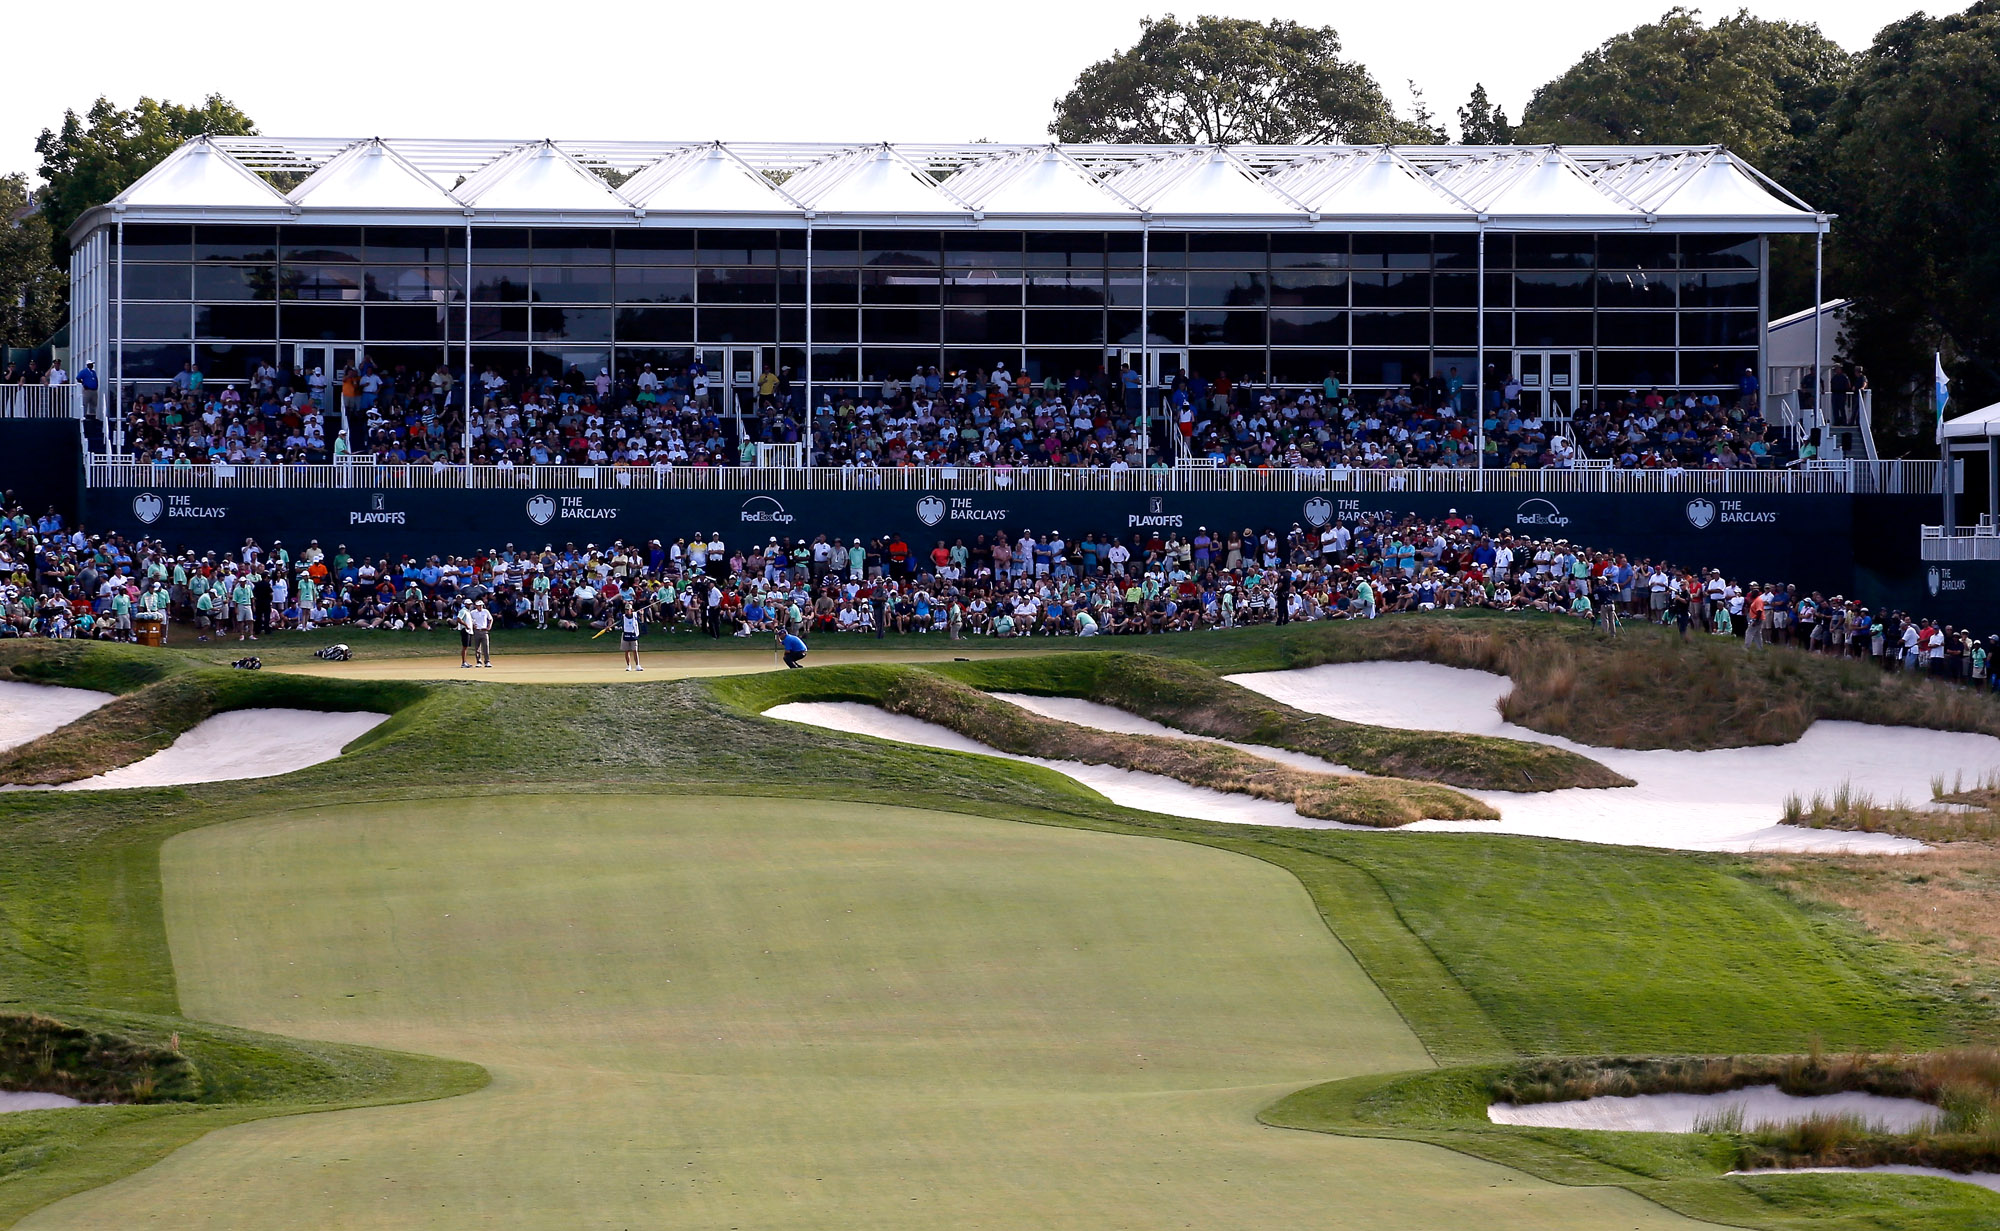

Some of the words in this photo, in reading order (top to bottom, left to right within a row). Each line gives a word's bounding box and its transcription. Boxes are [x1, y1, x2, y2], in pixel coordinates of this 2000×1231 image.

[168, 495, 190, 506] THE
[560, 496, 583, 507] THE
[950, 498, 972, 509] THE
[1337, 499, 1360, 510] THE
[1720, 500, 1742, 511] THE
[168, 507, 226, 518] BARCLAYS
[350, 511, 406, 525] PLAYOFFS
[561, 508, 617, 519] BARCLAYS
[741, 511, 793, 525] FedExCup
[951, 509, 1006, 520] BARCLAYS
[1721, 511, 1776, 523] BARCLAYS
[1128, 514, 1183, 528] PLAYOFFS
[1516, 513, 1569, 527] FedExCup
[1941, 568, 1951, 579] THE
[1941, 579, 1966, 590] BARCLAYS
